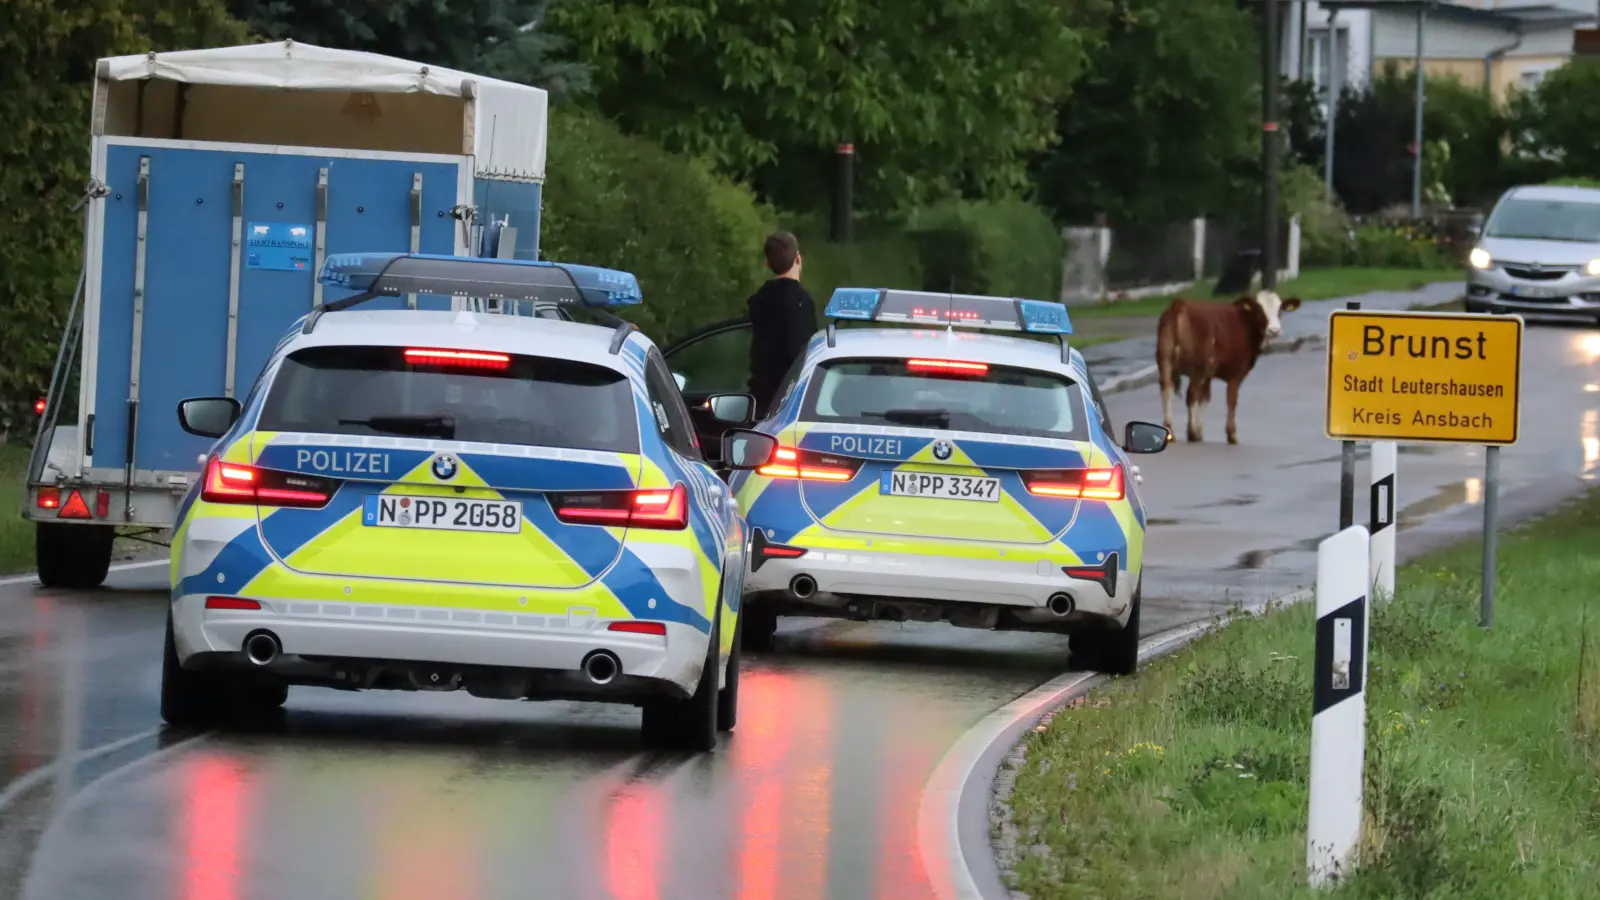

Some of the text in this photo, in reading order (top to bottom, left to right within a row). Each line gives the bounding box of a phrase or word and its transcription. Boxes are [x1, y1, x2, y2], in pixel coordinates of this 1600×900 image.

[1363, 325, 1487, 359] Brunst
[1343, 374, 1504, 398] Stadt Leutershausen
[1352, 407, 1493, 428] Kreis Ansbach
[831, 435, 901, 455] POLIZEI
[297, 449, 389, 473] POLIZEI
[893, 474, 905, 493] N
[919, 476, 944, 495] PP
[948, 478, 997, 498] 3347
[379, 499, 396, 522] N
[415, 501, 447, 525] PP
[453, 502, 516, 528] 2058
